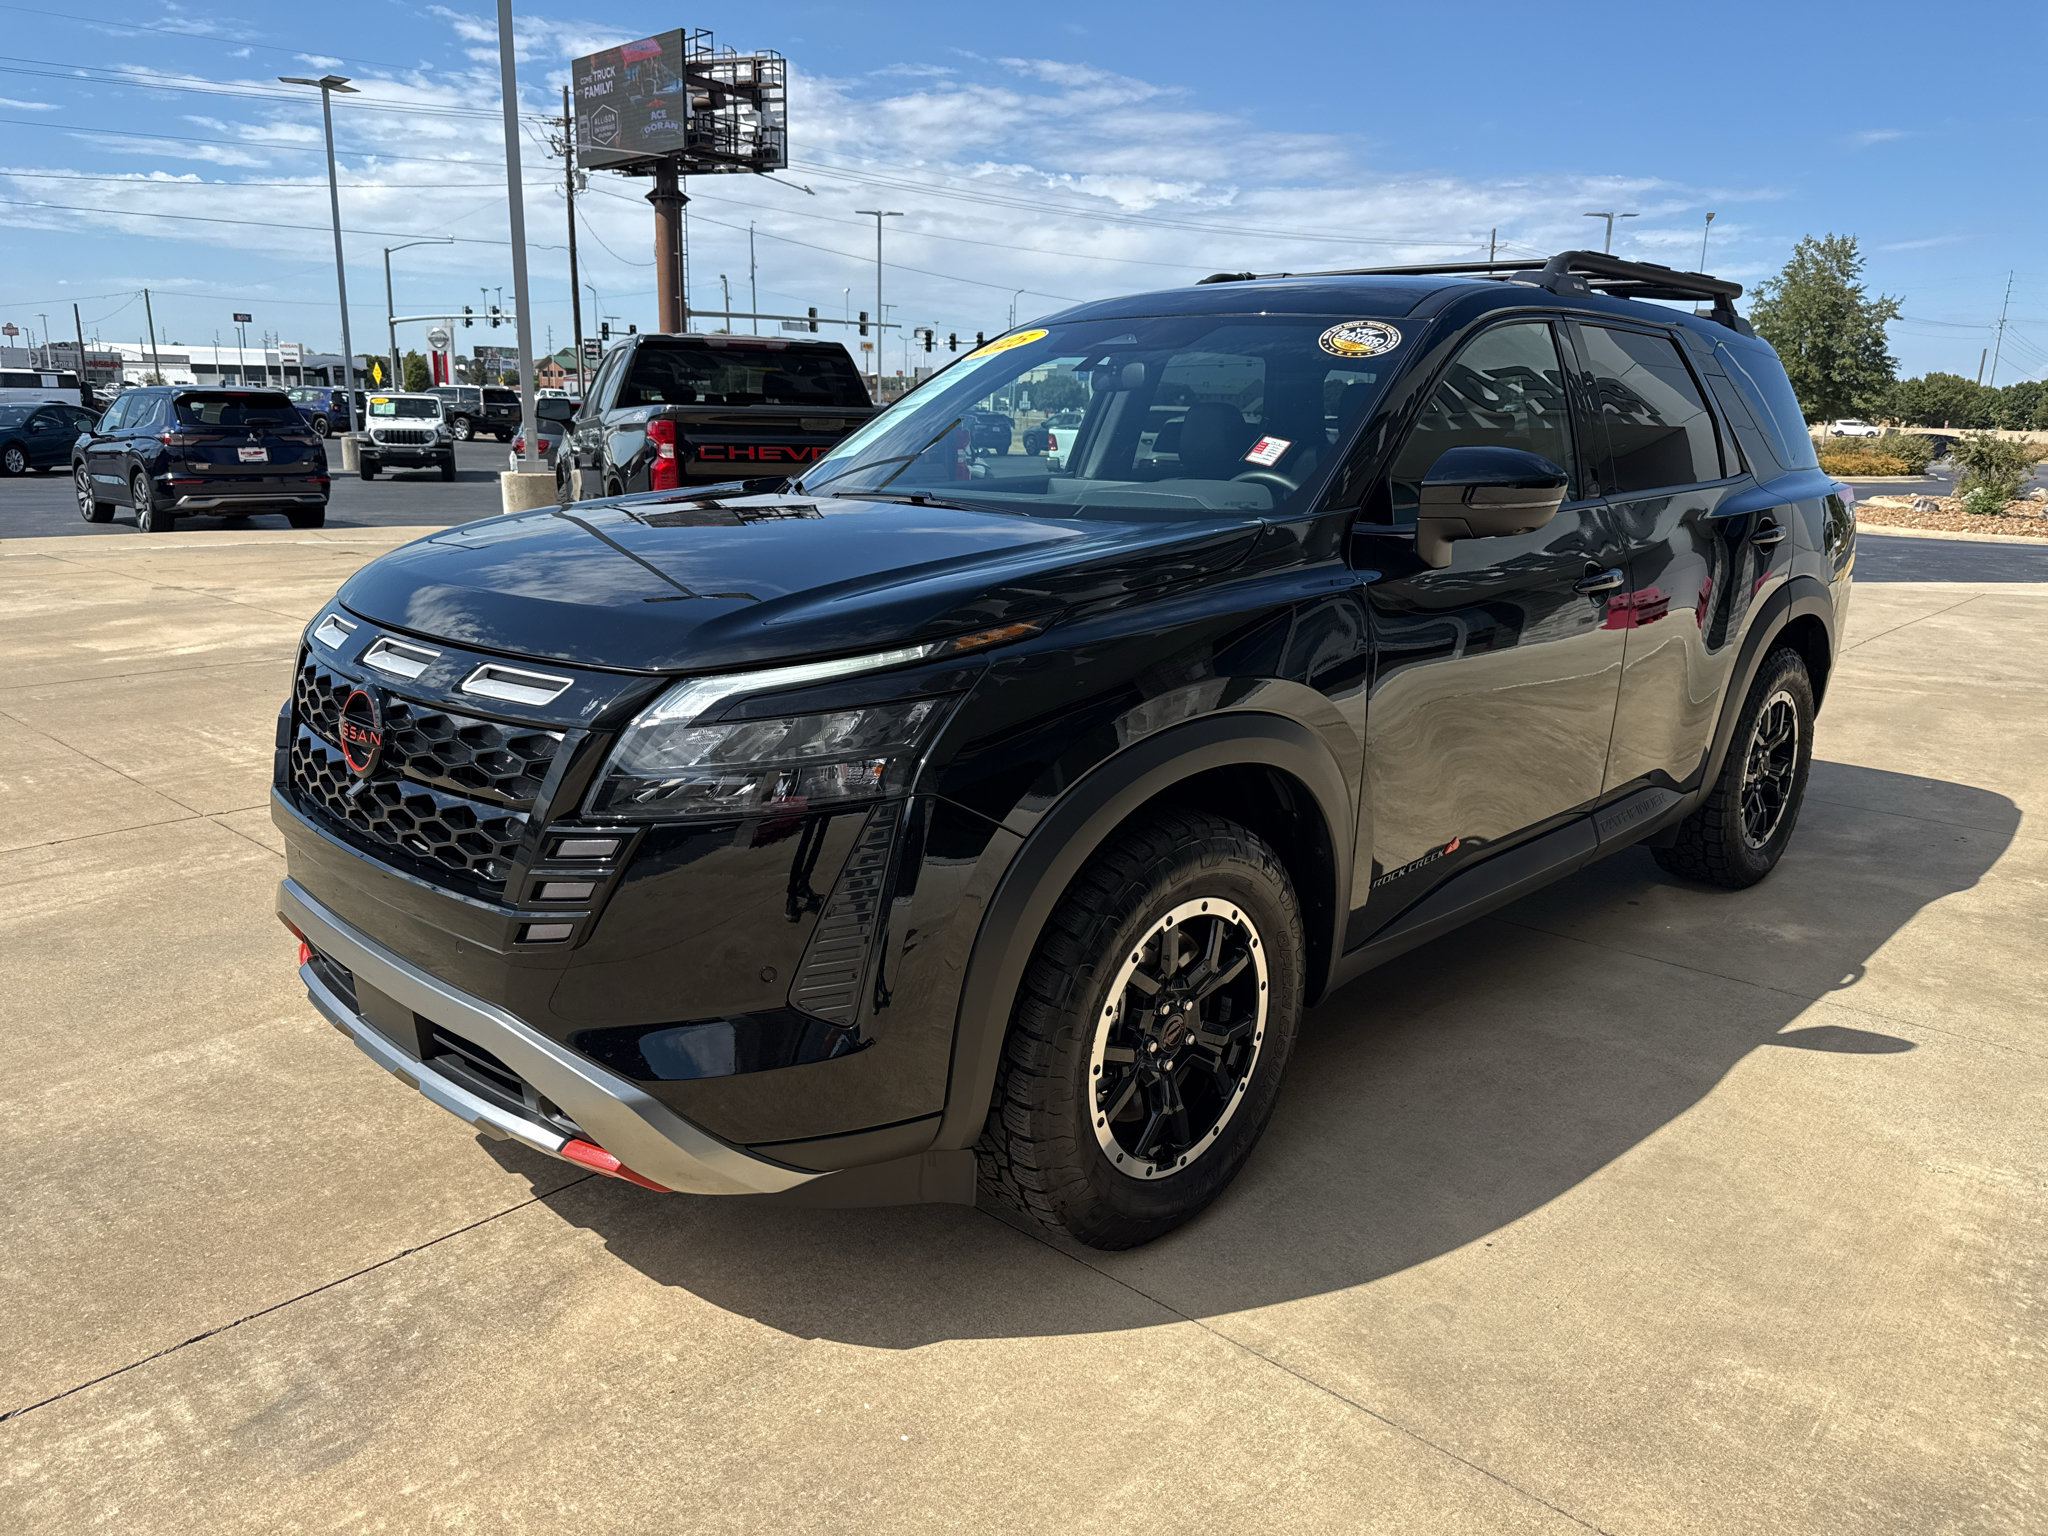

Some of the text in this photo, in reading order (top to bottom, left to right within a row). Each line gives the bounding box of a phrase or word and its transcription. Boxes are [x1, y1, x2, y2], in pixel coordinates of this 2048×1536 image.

[593, 66, 616, 80] TRUCK
[584, 81, 613, 99] FAMILY!
[651, 110, 667, 120] ACE
[643, 121, 678, 134] DORAN
[1335, 328, 1385, 344] BAYIRD
[88, 360, 121, 368] NISSAN
[1373, 848, 1445, 889] ROCK CREEK
